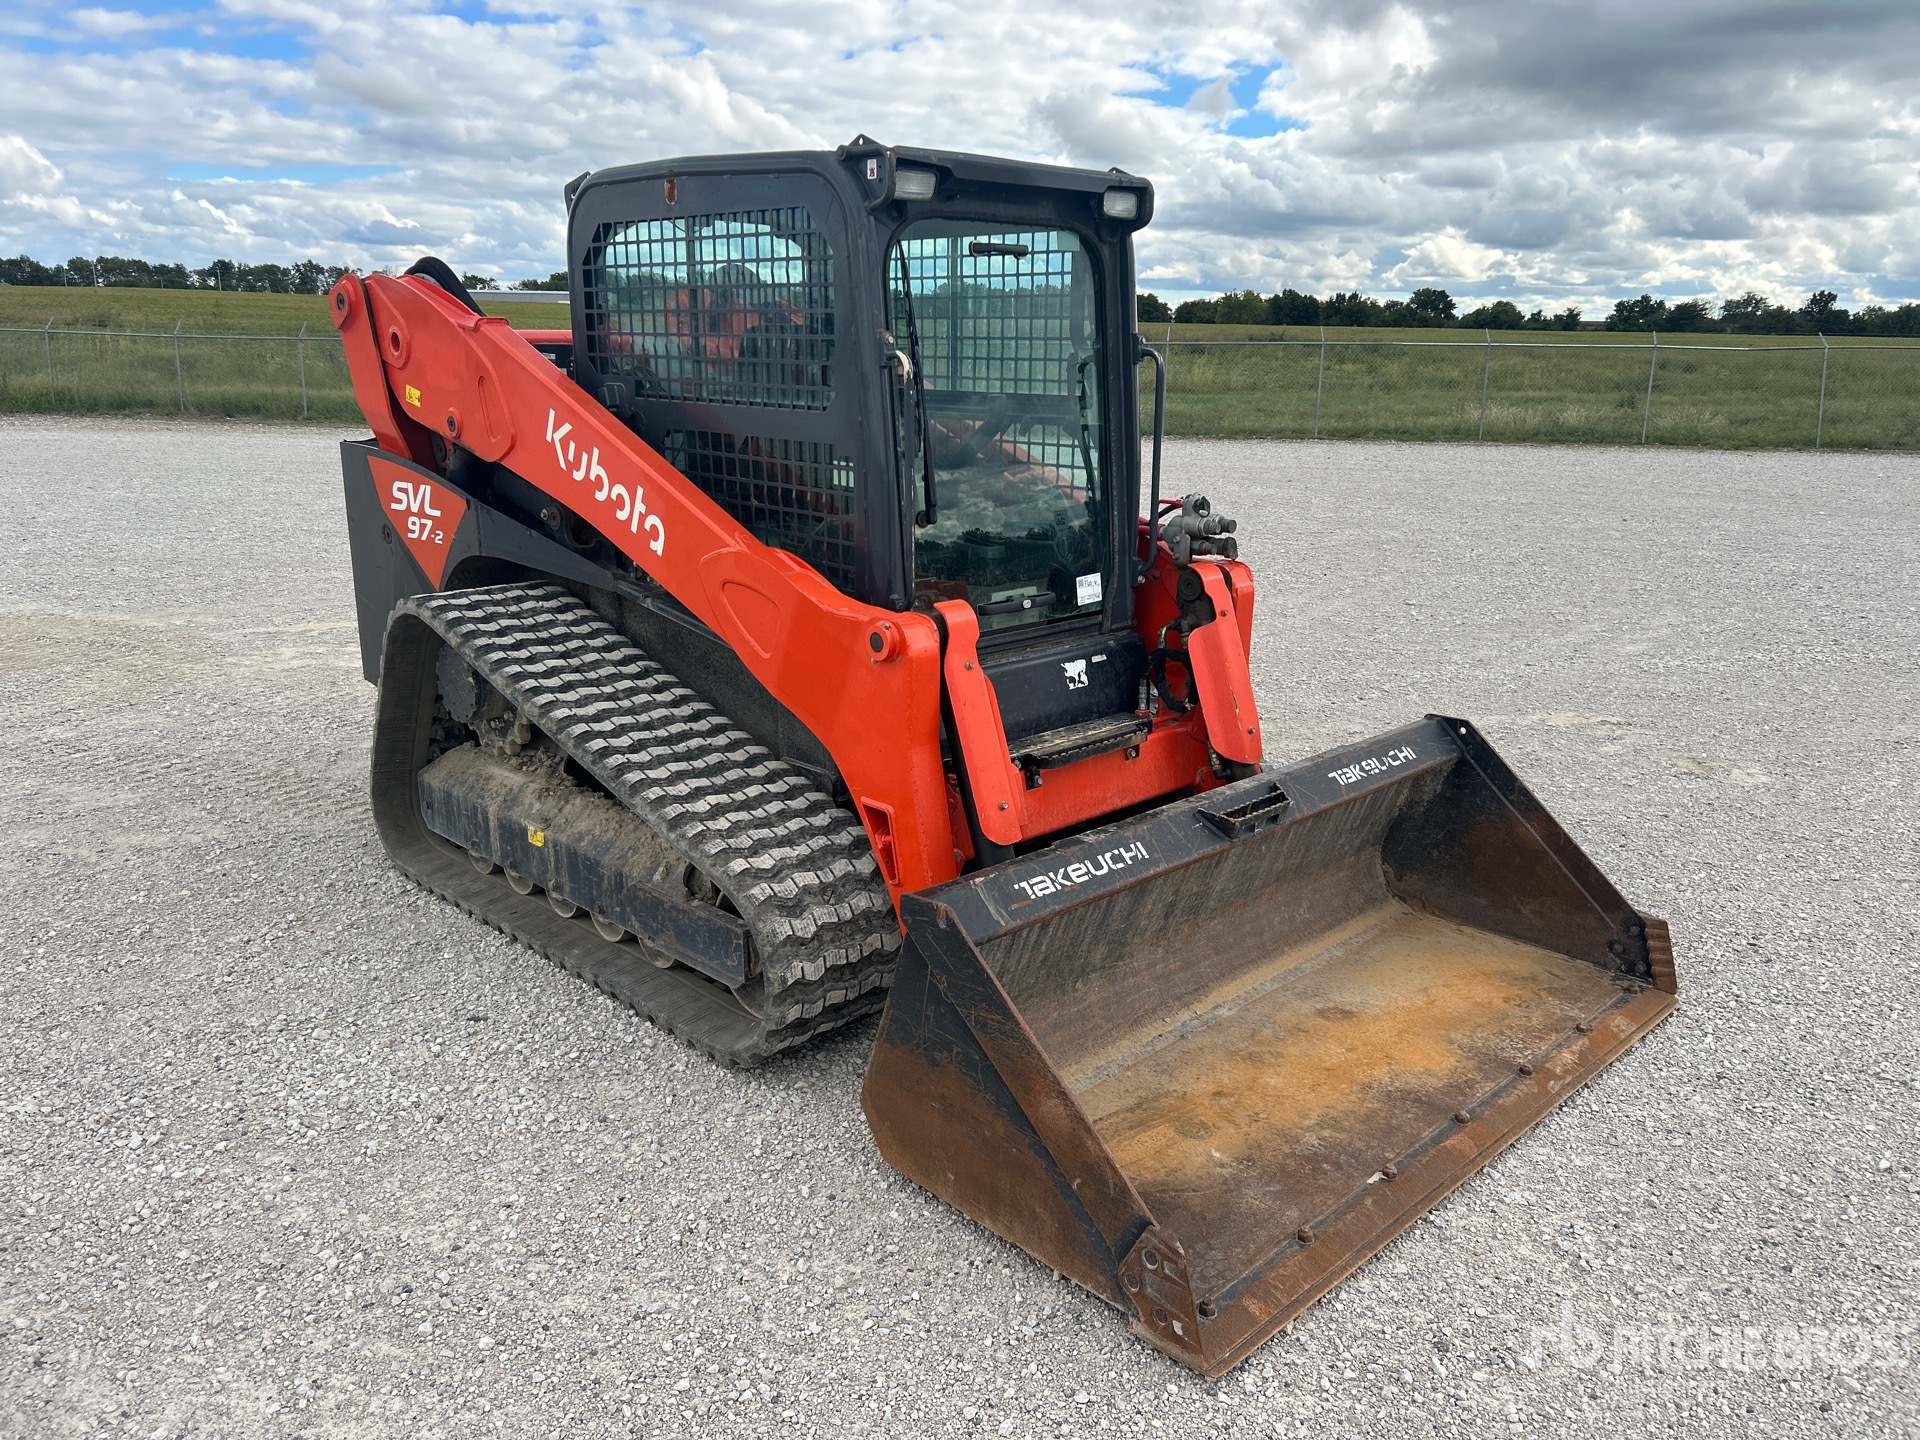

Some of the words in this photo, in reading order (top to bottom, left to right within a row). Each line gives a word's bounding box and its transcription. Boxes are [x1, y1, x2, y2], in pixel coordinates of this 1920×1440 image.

[391, 481, 441, 517] SVL
[545, 407, 665, 557] Kubota
[407, 516, 444, 544] 97-2
